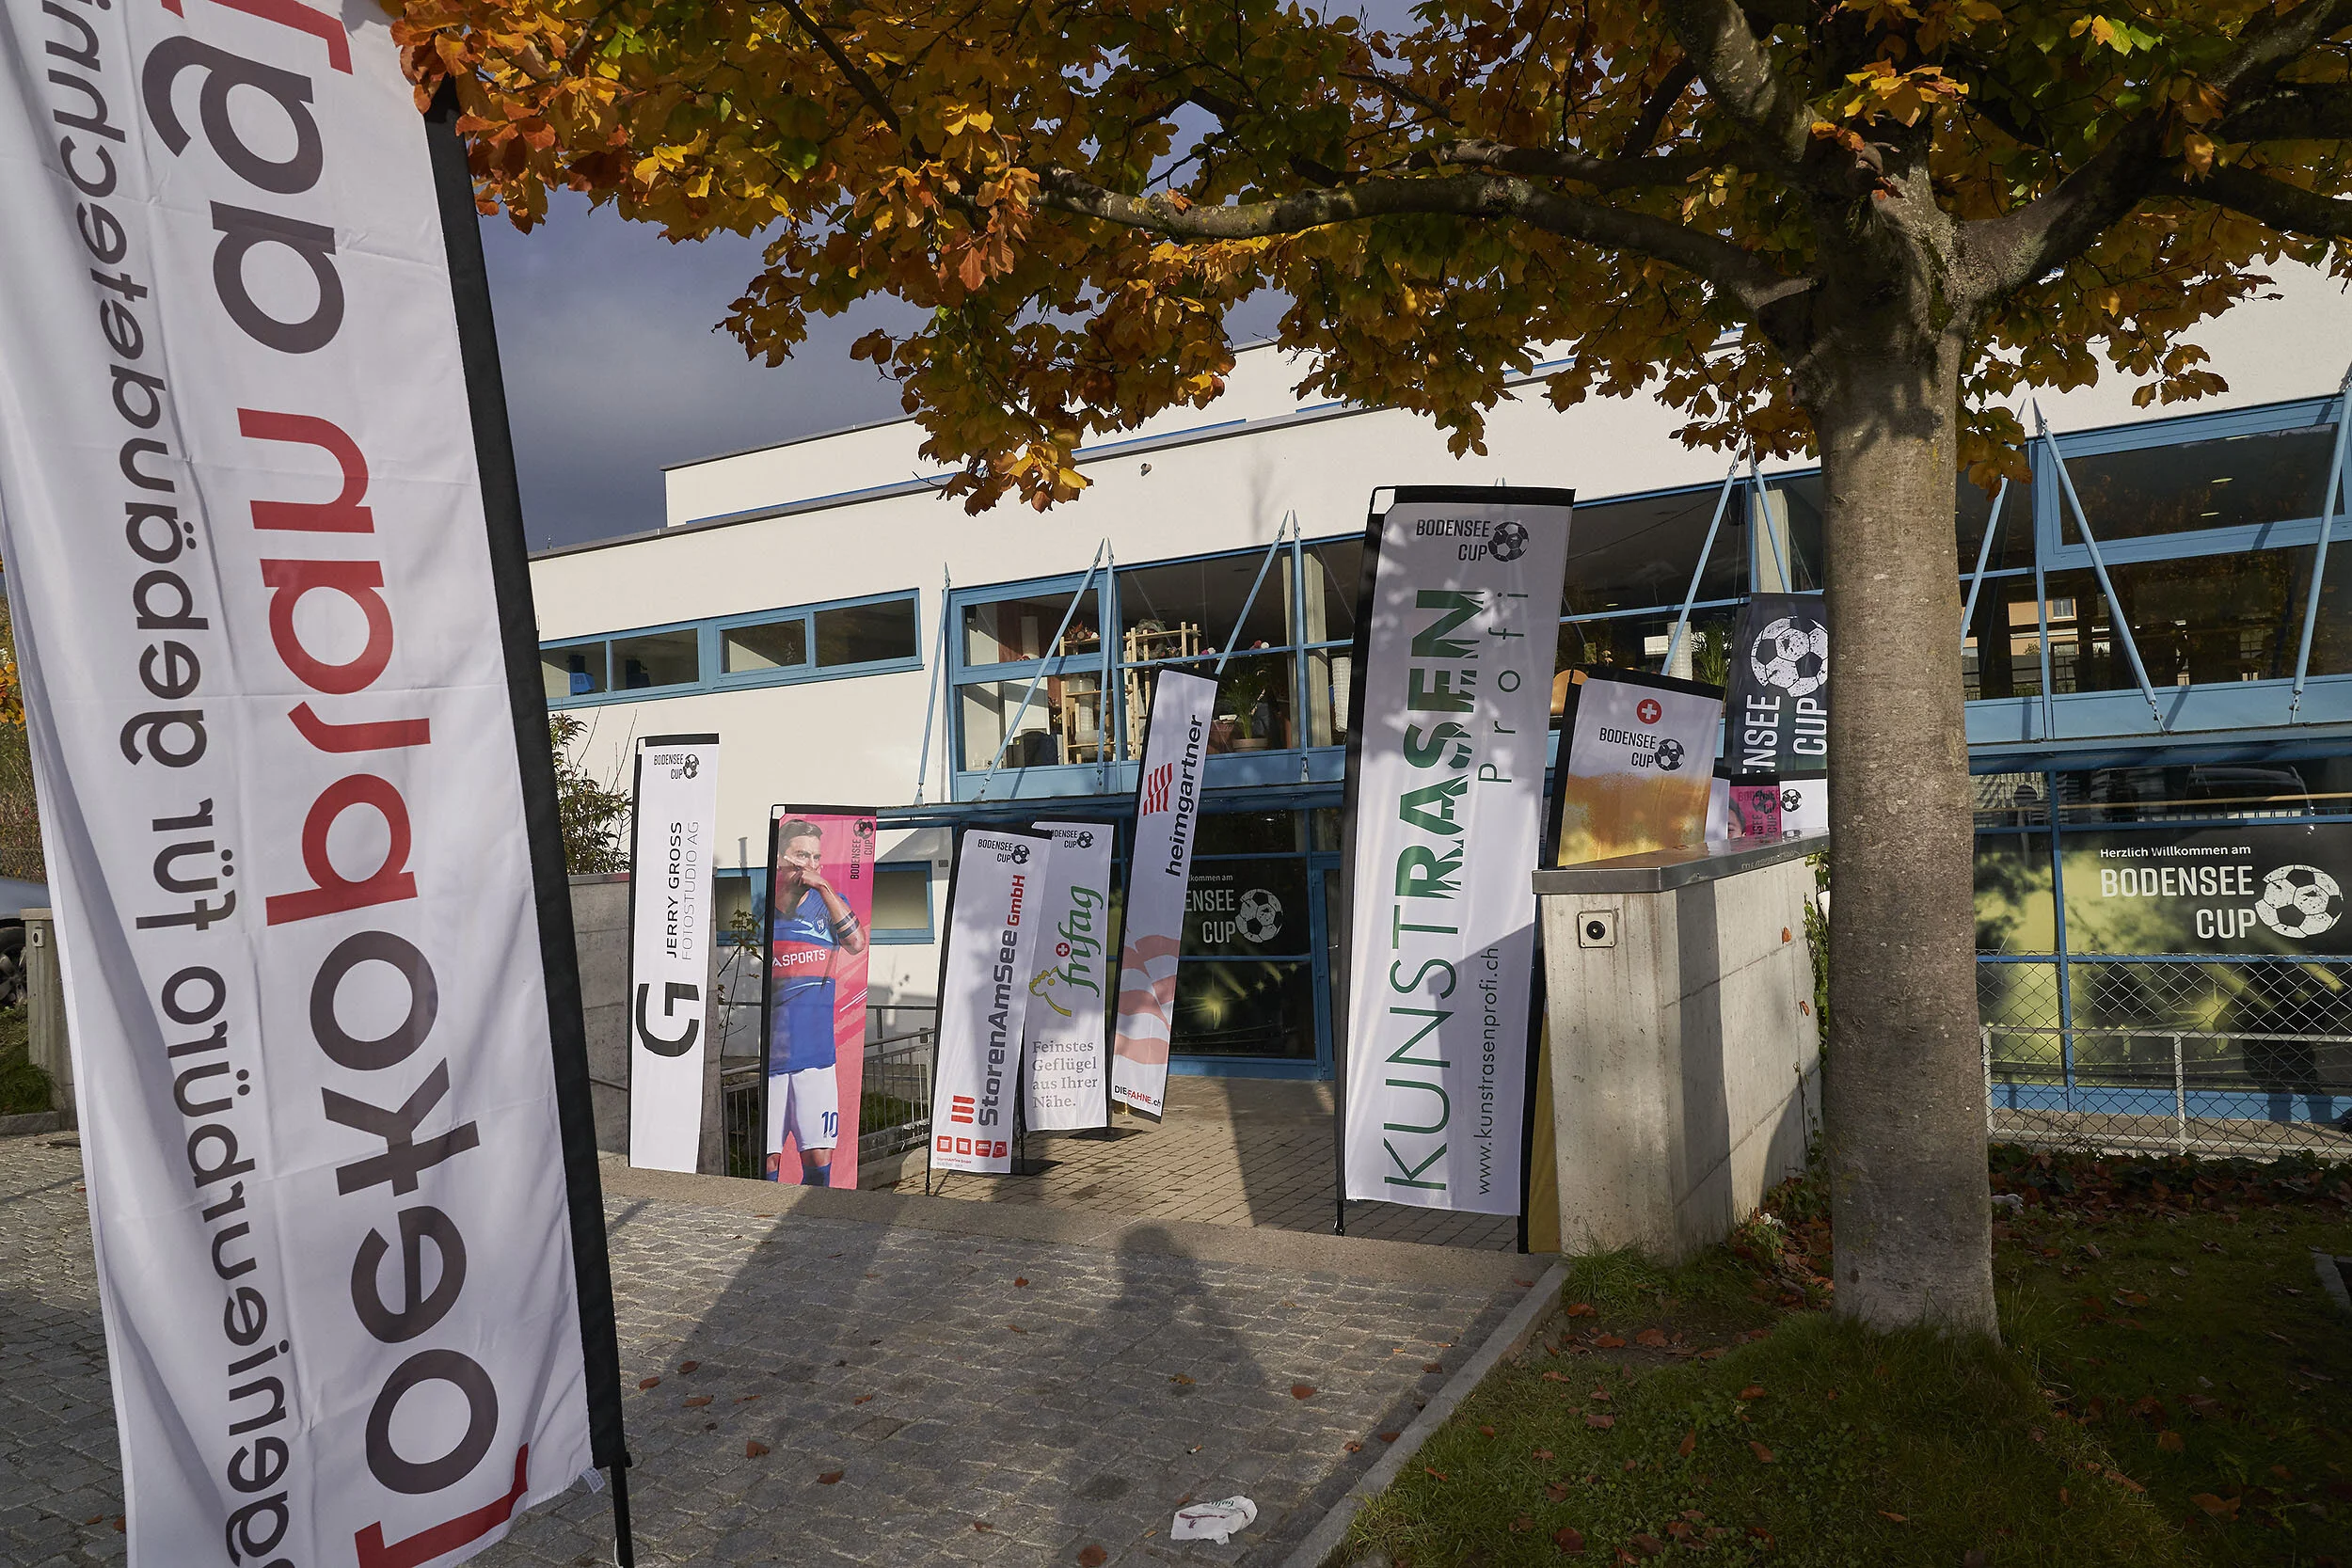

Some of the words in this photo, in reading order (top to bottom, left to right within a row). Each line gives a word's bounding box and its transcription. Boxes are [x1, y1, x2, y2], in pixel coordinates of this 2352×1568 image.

[1415, 518, 1491, 539] BODENSEE
[1458, 543, 1488, 562] CUP
[1792, 697, 1828, 756] CUP
[1598, 727, 1658, 751] BODENSEE
[653, 753, 684, 766] BODENSEE
[1630, 752, 1655, 768] CUP
[670, 768, 683, 780] CUP
[1165, 714, 1203, 878] heimgartner
[688, 821, 699, 846] AG
[977, 838, 1013, 852] BODENSEE
[1063, 840, 1077, 848] CUP
[668, 821, 682, 890] GROSS
[850, 838, 862, 879] BODENSEE
[864, 839, 874, 856] CUP
[996, 853, 1011, 863] CUP
[2100, 848, 2149, 858] Herzlich
[2151, 847, 2230, 857] Willkommen
[2231, 847, 2251, 855] am
[1384, 589, 1486, 1191] KUNSTRASEN
[2100, 864, 2255, 897] BODENSEE
[682, 848, 697, 960] FOTOSTUDIO
[666, 895, 679, 959] JERRY
[1201, 921, 1236, 944] CUP
[2196, 909, 2257, 939] CUP
[1056, 885, 1105, 999] frifag
[977, 929, 1018, 1127] StorenAmSee
[1007, 875, 1025, 927] GmbH
[1032, 1040, 1094, 1054] Feinstes
[1032, 1056, 1097, 1073] Geflügel
[1473, 946, 1502, 1196] www.kunstrasenprofi.ch
[1032, 1079, 1057, 1090] aus
[1061, 1076, 1098, 1089] Ihrer
[1032, 1094, 1076, 1109] Nähe.
[820, 1111, 839, 1138] 10
